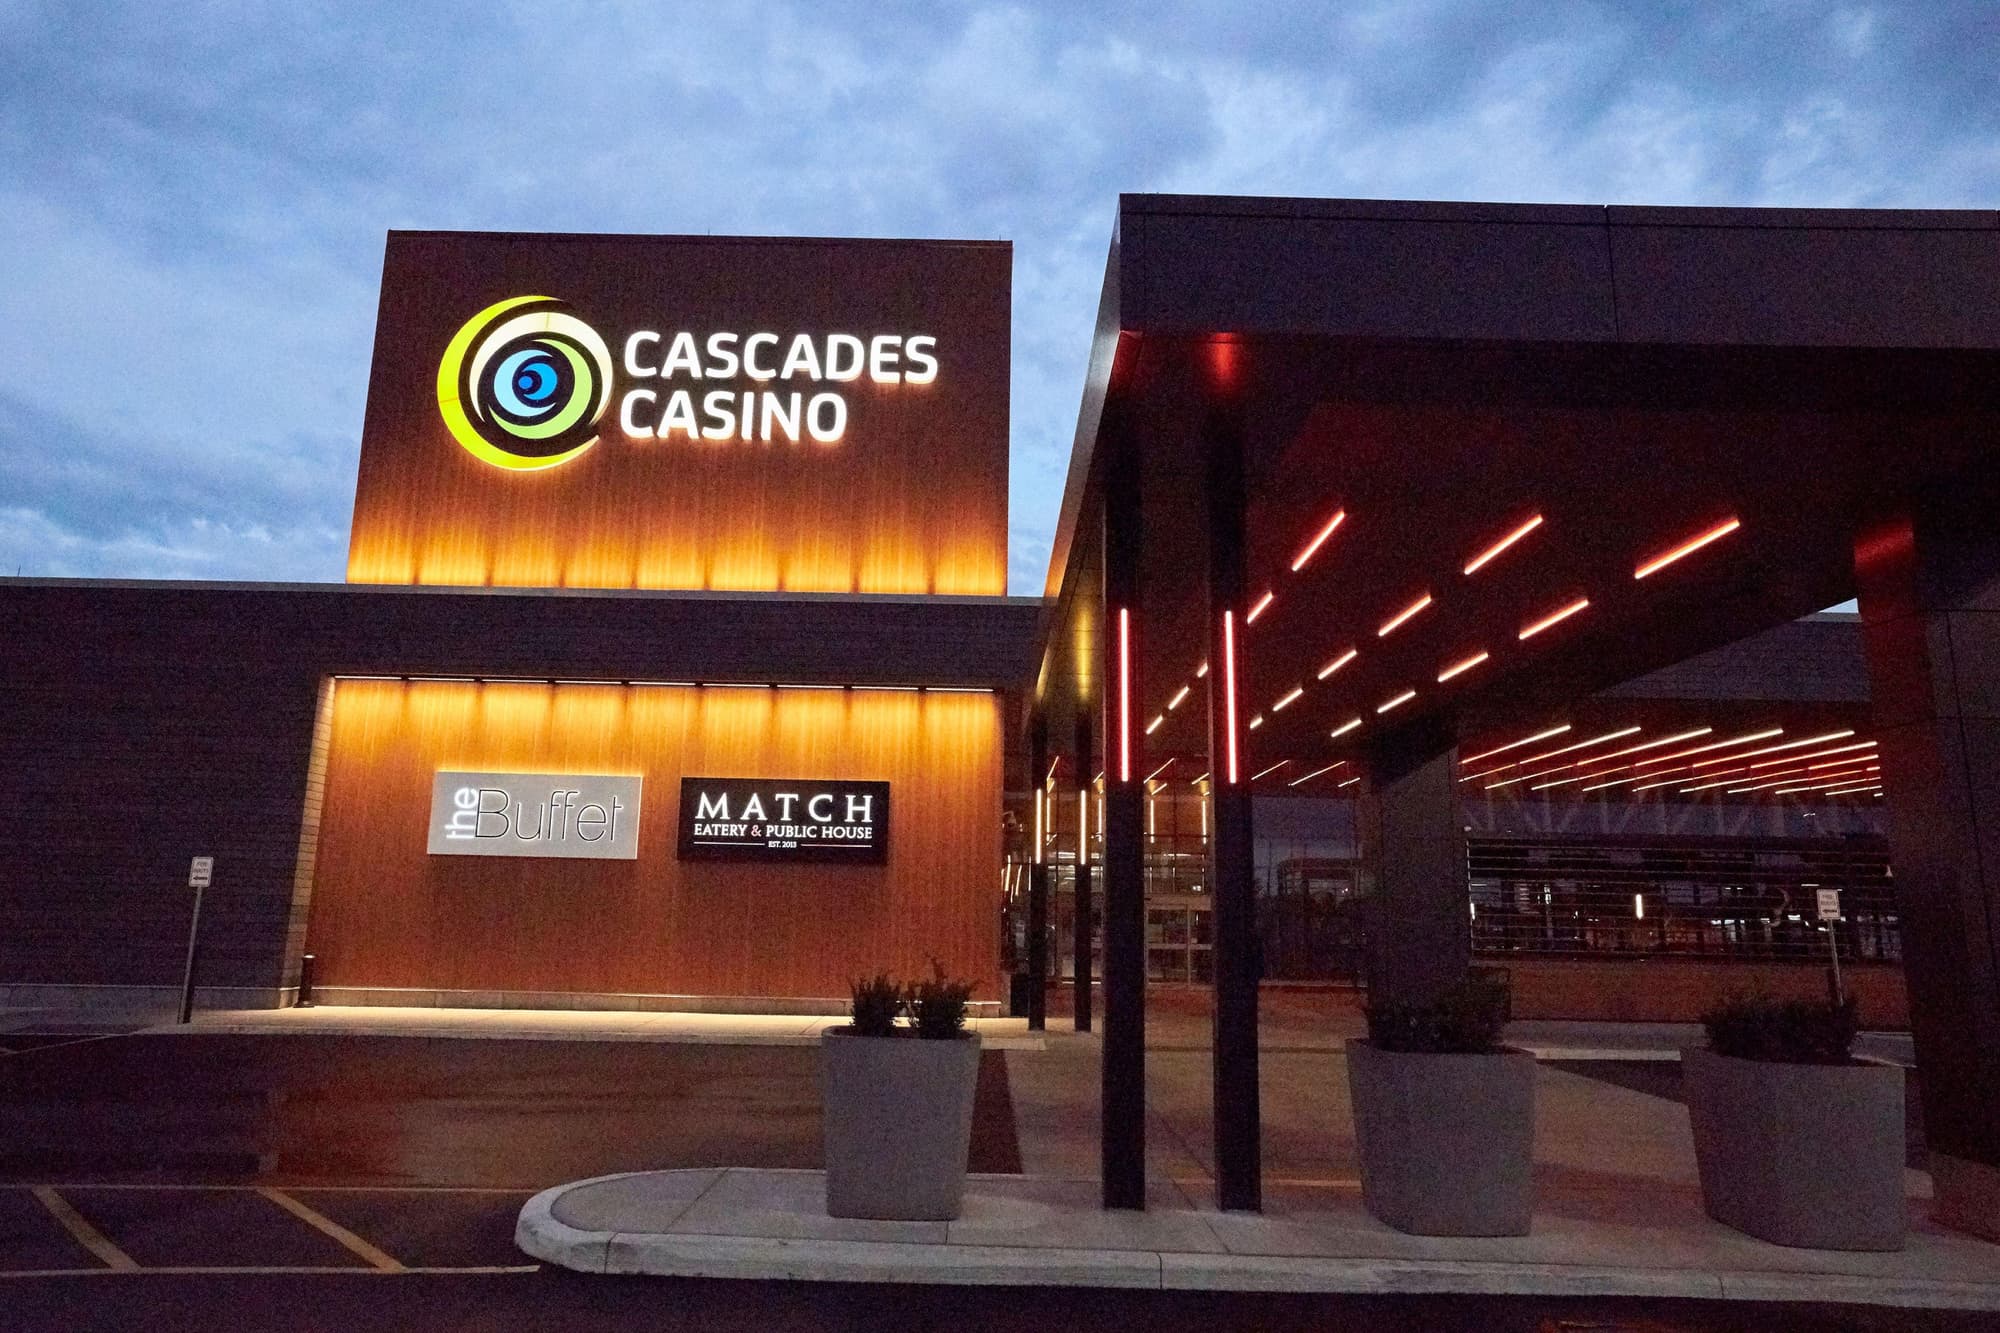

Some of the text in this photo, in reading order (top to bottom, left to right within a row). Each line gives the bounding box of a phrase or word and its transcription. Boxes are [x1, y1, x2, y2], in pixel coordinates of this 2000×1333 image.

[624, 331, 938, 384] CASCADES
[619, 390, 848, 442] CASINO
[444, 787, 479, 840] the
[474, 788, 623, 842] Buffet
[694, 823, 873, 839] EATERY & PUBLIC HOUSE
[695, 791, 873, 822] MATCH
